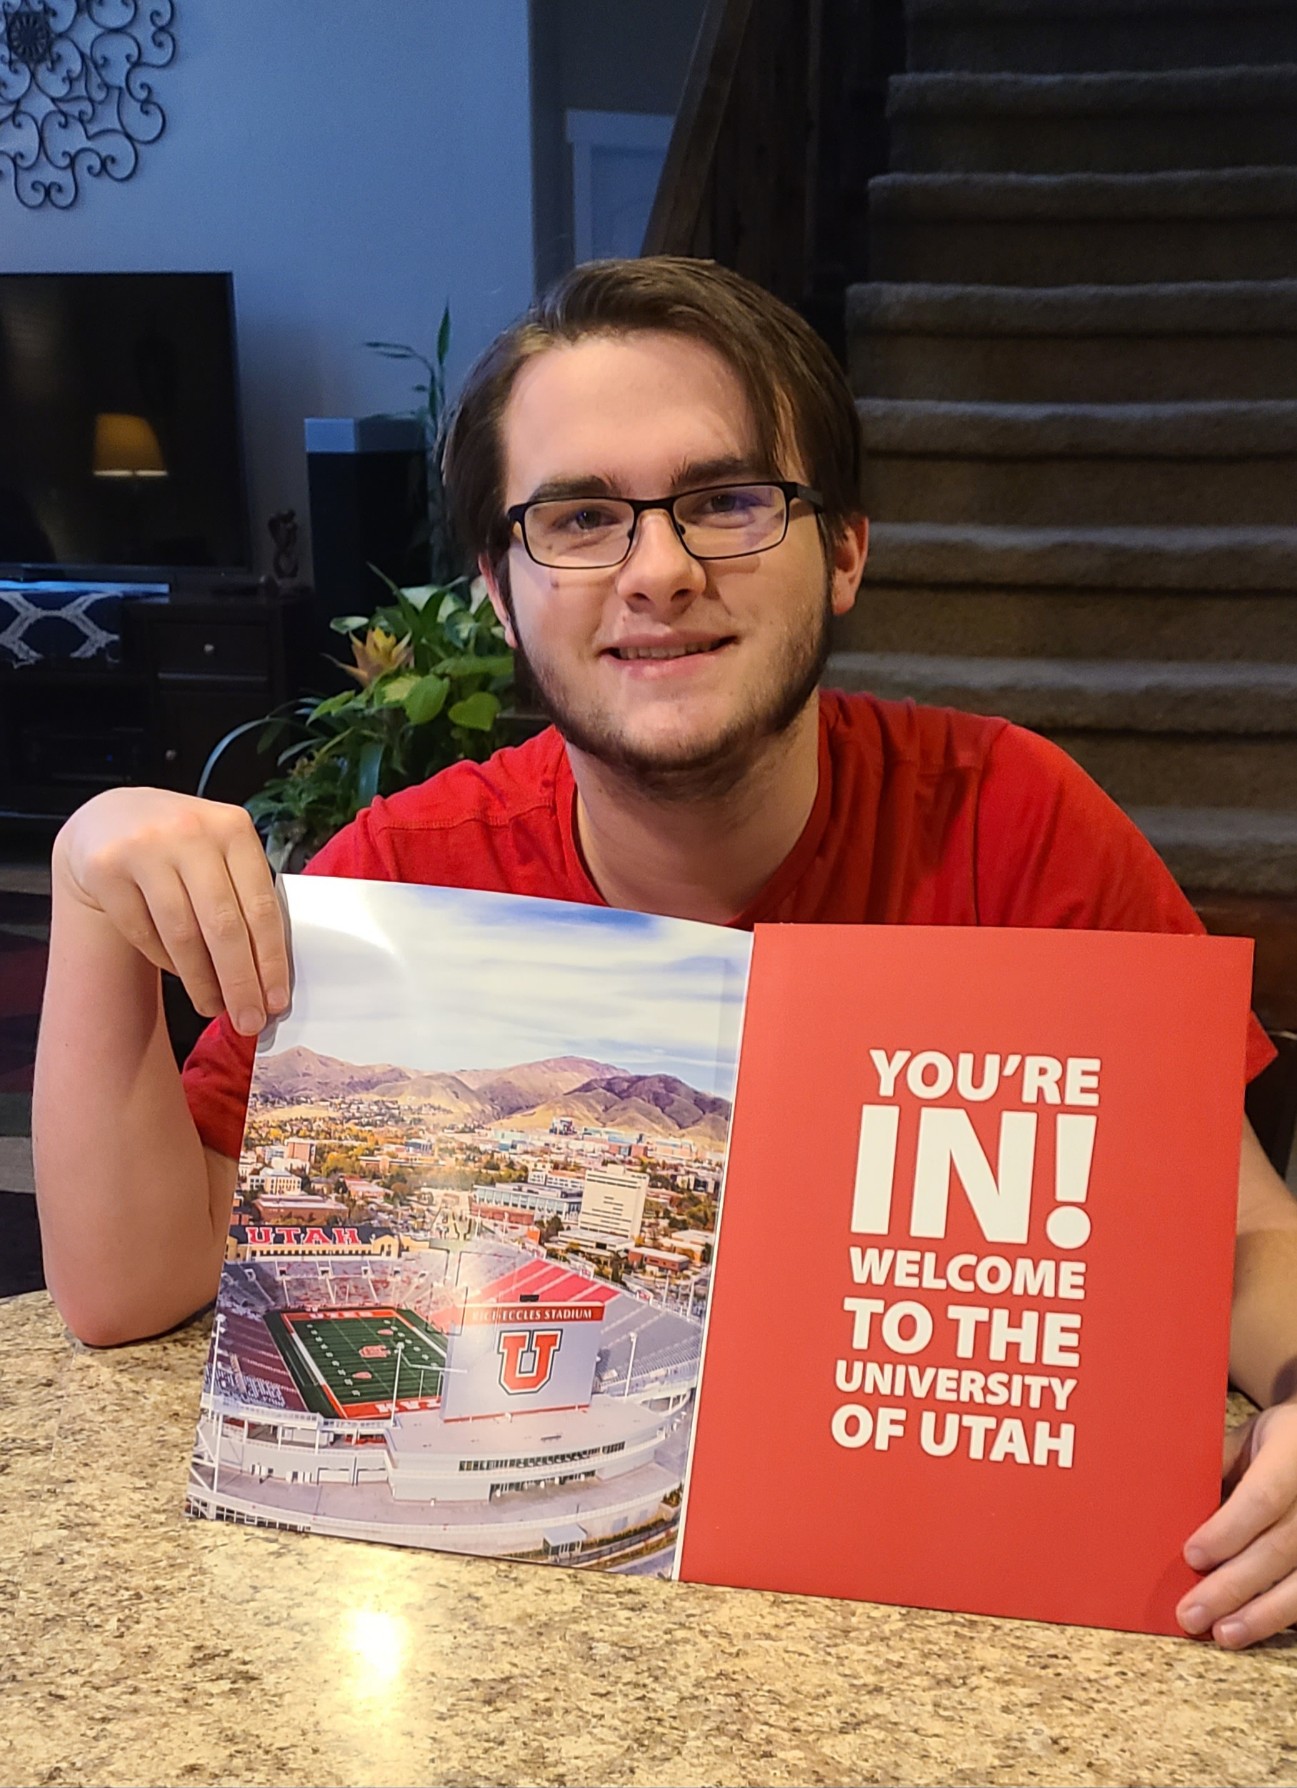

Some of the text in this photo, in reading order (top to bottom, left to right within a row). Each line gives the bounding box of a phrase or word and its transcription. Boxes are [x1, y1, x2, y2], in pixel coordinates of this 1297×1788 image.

[869, 1049, 1101, 1107] YOU'RE
[850, 1104, 1097, 1249] IN!
[246, 1226, 361, 1245] UTAH
[849, 1246, 1086, 1300] WELCOME
[544, 1308, 592, 1320] STADIUM
[843, 1297, 1082, 1367] TO THE
[497, 1328, 564, 1396] U
[835, 1359, 1077, 1411] UNIVERSITY
[831, 1403, 1075, 1468] OF UTAH
